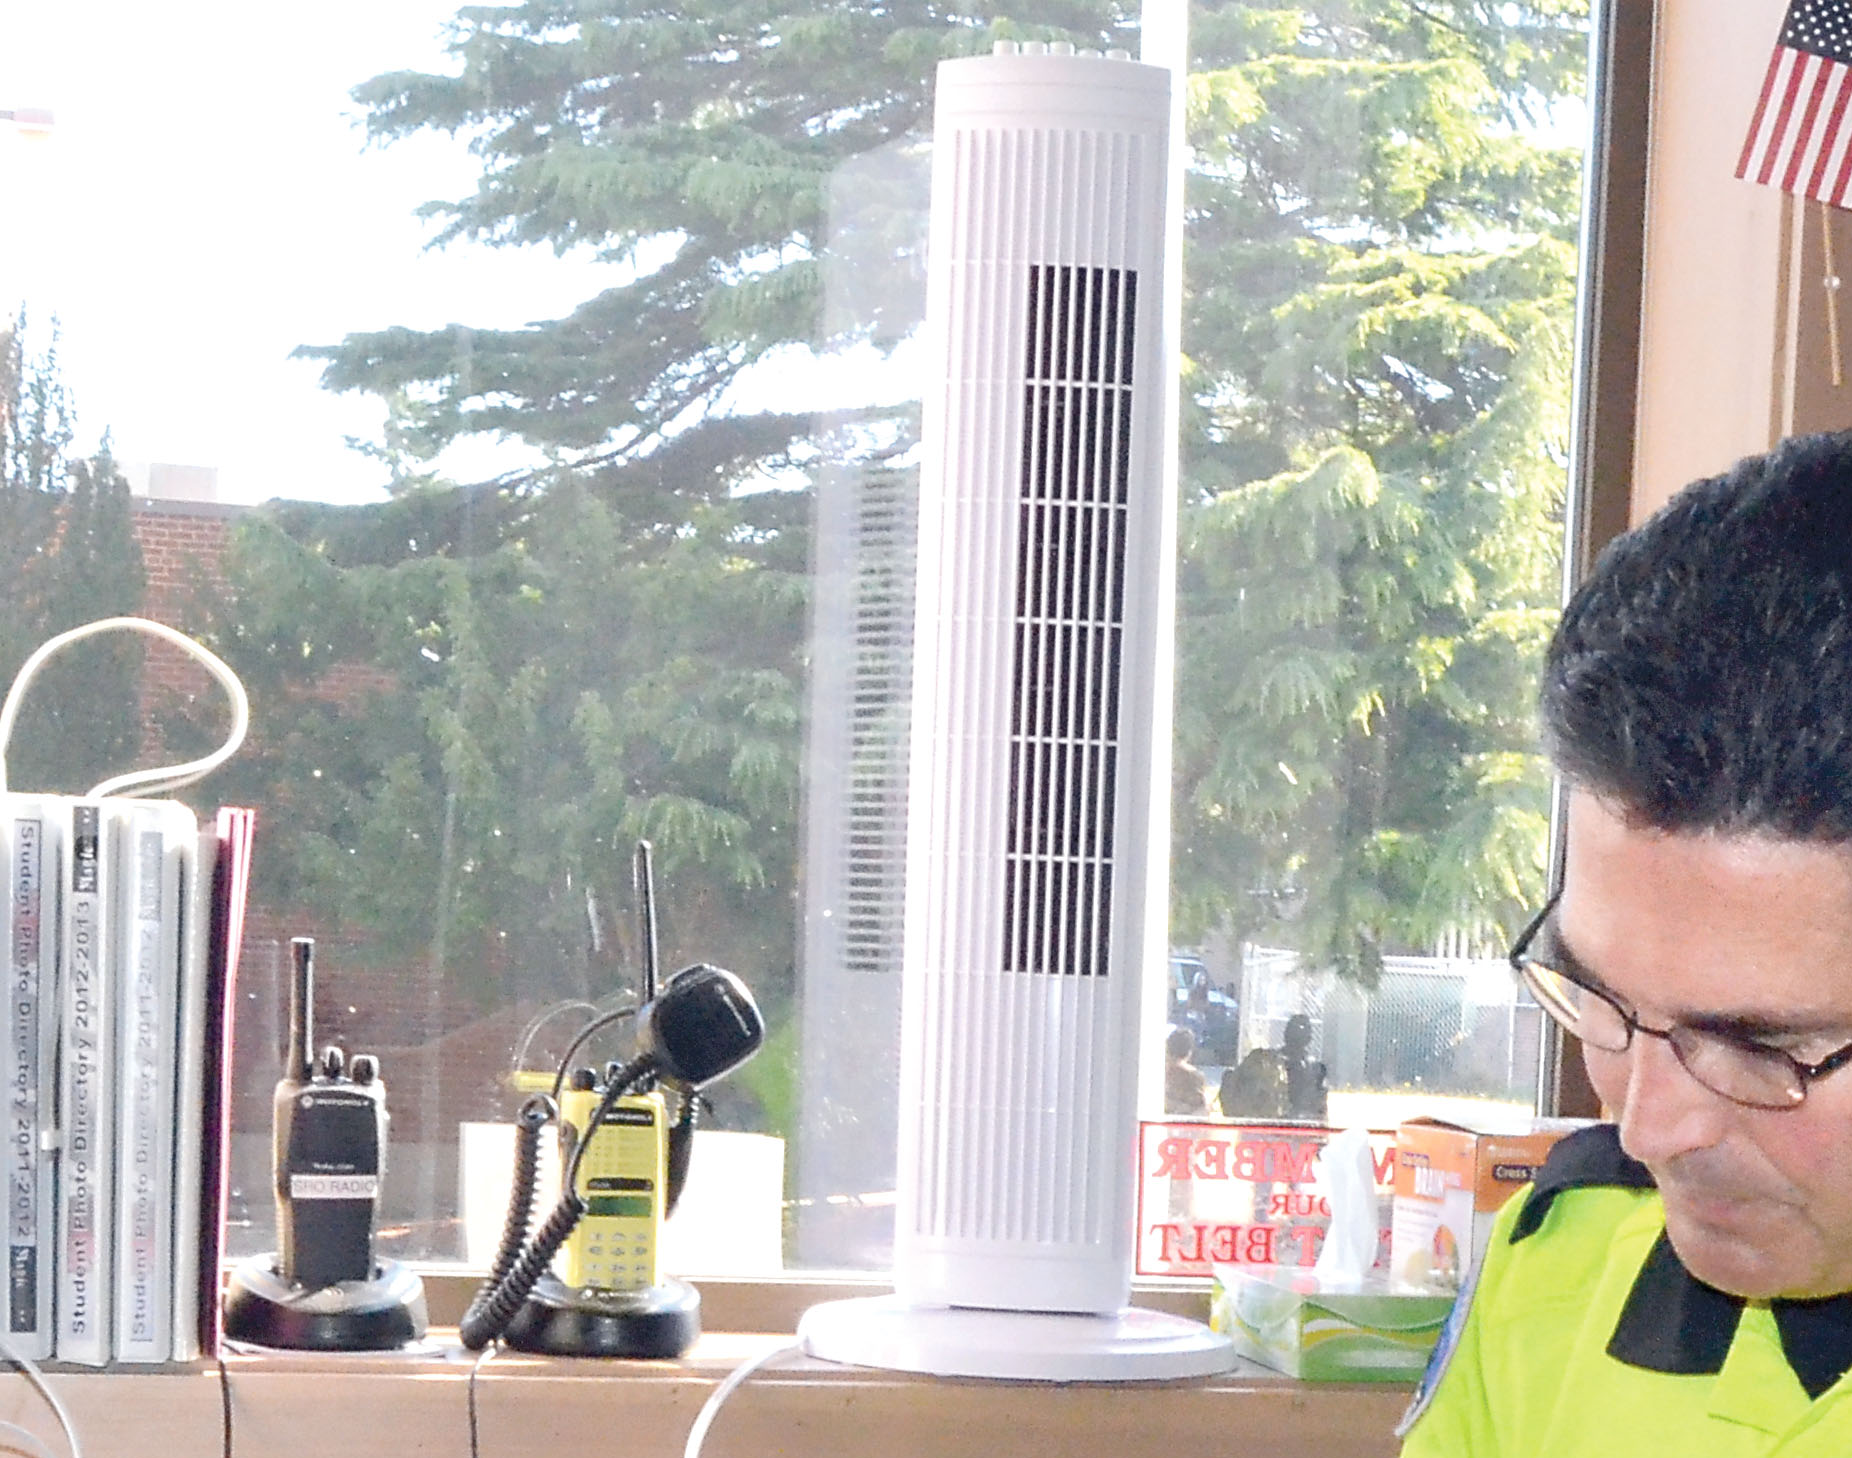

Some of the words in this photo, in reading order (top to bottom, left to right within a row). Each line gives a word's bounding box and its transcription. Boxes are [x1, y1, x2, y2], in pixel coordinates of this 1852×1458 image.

[18, 825, 35, 917] Student
[18, 925, 33, 992] Photo
[75, 900, 90, 1029] 2012-2013
[75, 1036, 92, 1152] Directory
[17, 1118, 31, 1238] 2011-2012
[73, 1160, 88, 1230] Photo
[135, 1173, 150, 1241] Photo
[72, 1239, 87, 1335] Student
[133, 1247, 148, 1334] Student
